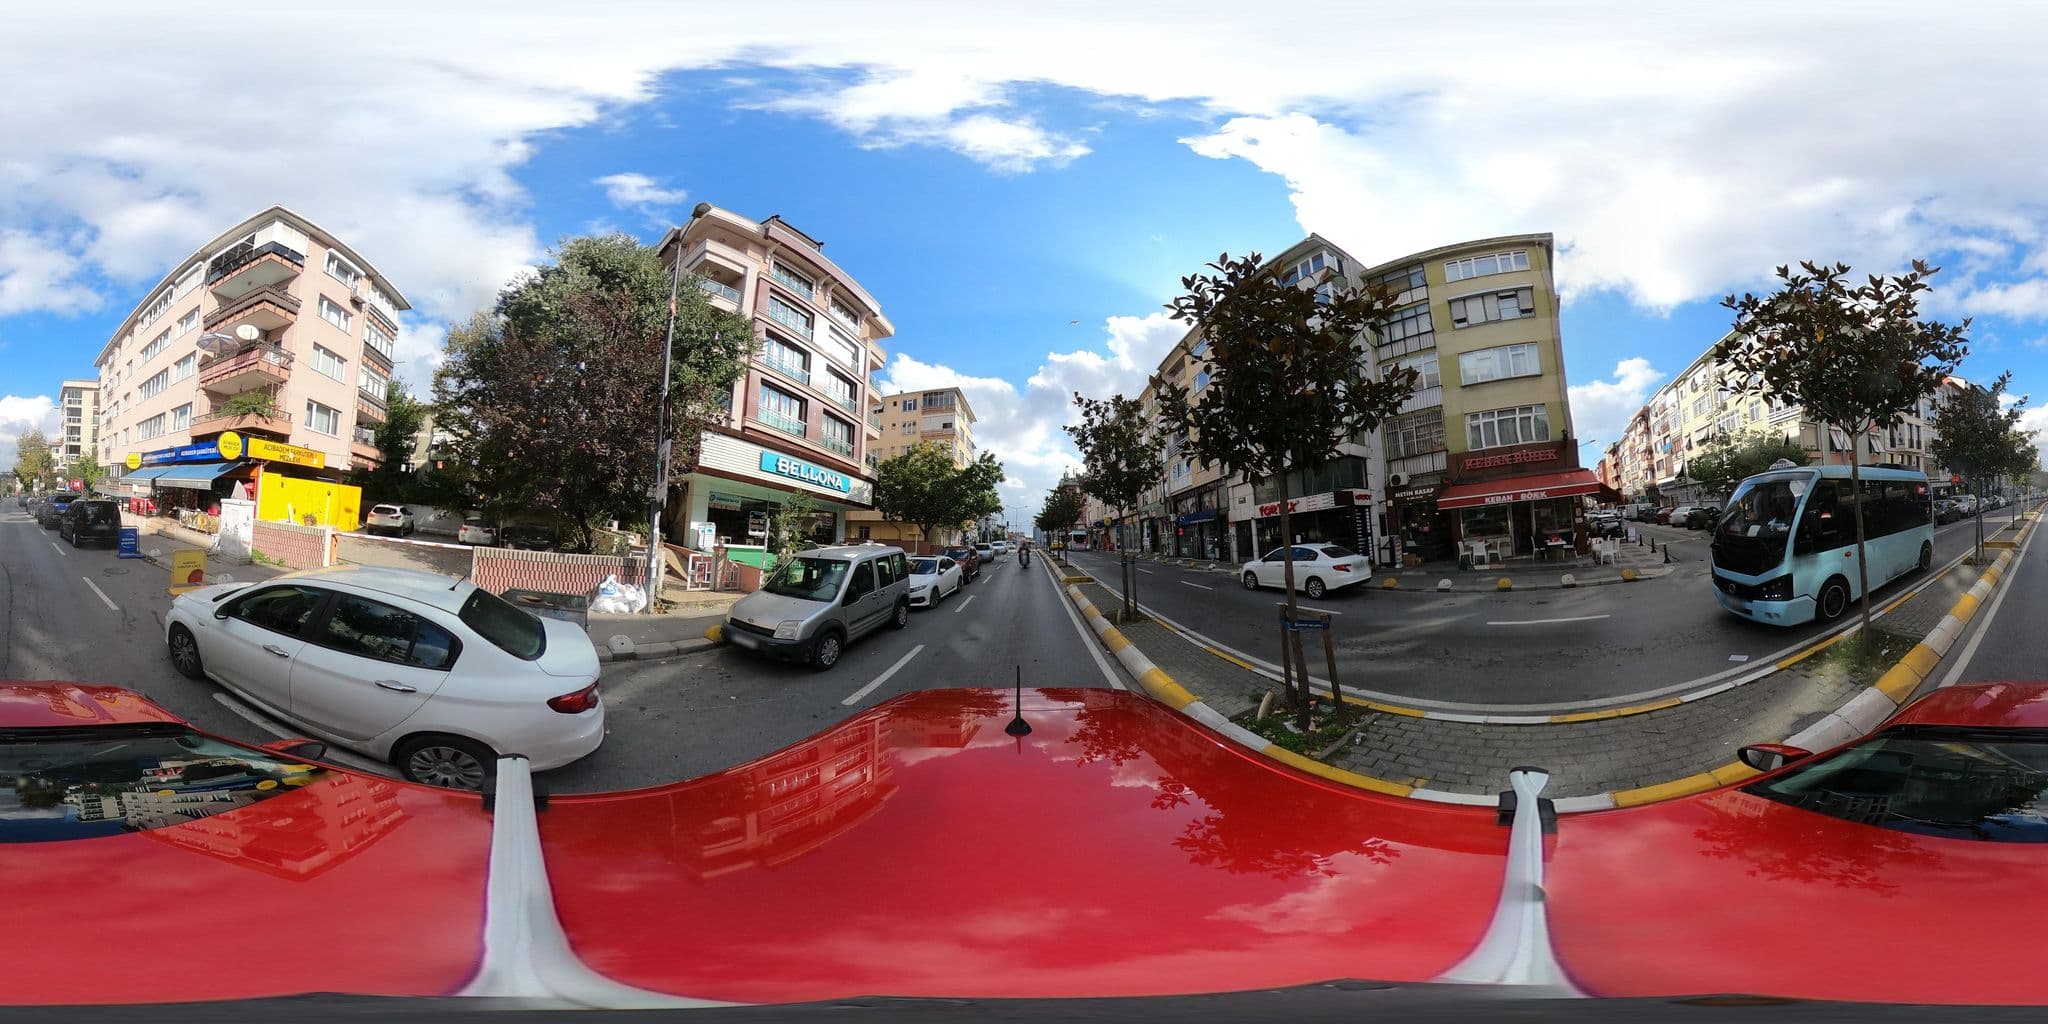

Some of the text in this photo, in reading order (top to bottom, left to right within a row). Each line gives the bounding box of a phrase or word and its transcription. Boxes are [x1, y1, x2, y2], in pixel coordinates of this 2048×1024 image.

[264, 443, 289, 454] ACIBADEM
[1465, 456, 1508, 470] KEBAN
[776, 457, 843, 489] BELLONA
[1414, 487, 1435, 496] KASAP
[1484, 493, 1513, 504] KEBAN
